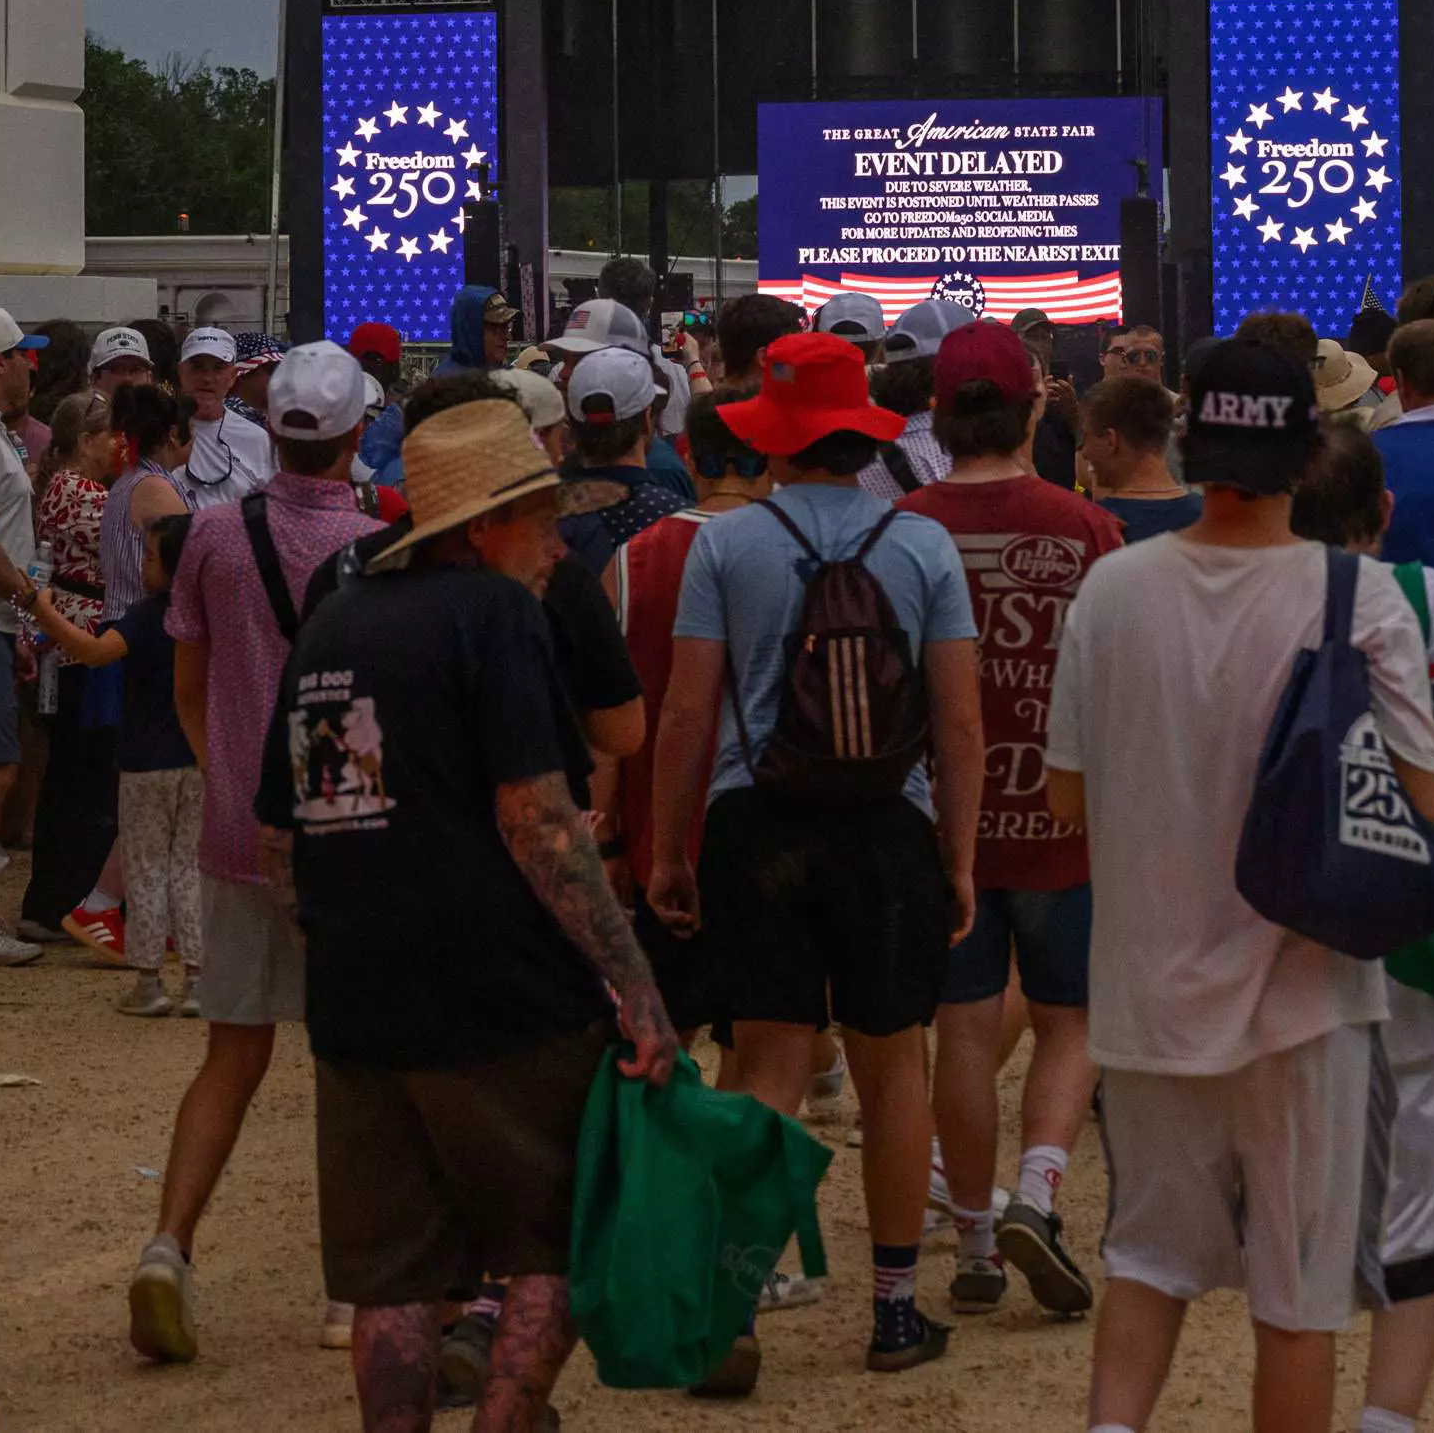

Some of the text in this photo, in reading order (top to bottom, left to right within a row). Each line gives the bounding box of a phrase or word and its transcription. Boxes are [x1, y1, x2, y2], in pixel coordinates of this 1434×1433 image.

[823, 112, 1096, 150] THE GREAT American STATE FAIR
[1257, 138, 1355, 158] Freedom
[365, 151, 456, 169] Freedom
[854, 150, 1063, 176] EVENT DELAYED
[366, 169, 456, 219] 250
[885, 179, 1032, 193] DUE TO SEVERE WEATHER,
[1258, 157, 1355, 208] 250
[819, 194, 1099, 209] THIS EVENT IS POSTPONED UNTIL WEATHER PASSES
[864, 210, 1055, 225] GO TO FREEDOM250 SOCIAL MEDIA
[841, 225, 1078, 239] FOR MORE UPDATES AND REOPENING TIMES
[798, 245, 1121, 264] PLEASE PROCEED TO THE NEAREST EXIT
[1199, 390, 1295, 428] ARMY
[1011, 549, 1076, 580] Pepper
[1351, 825, 1422, 854] FLORIDA
